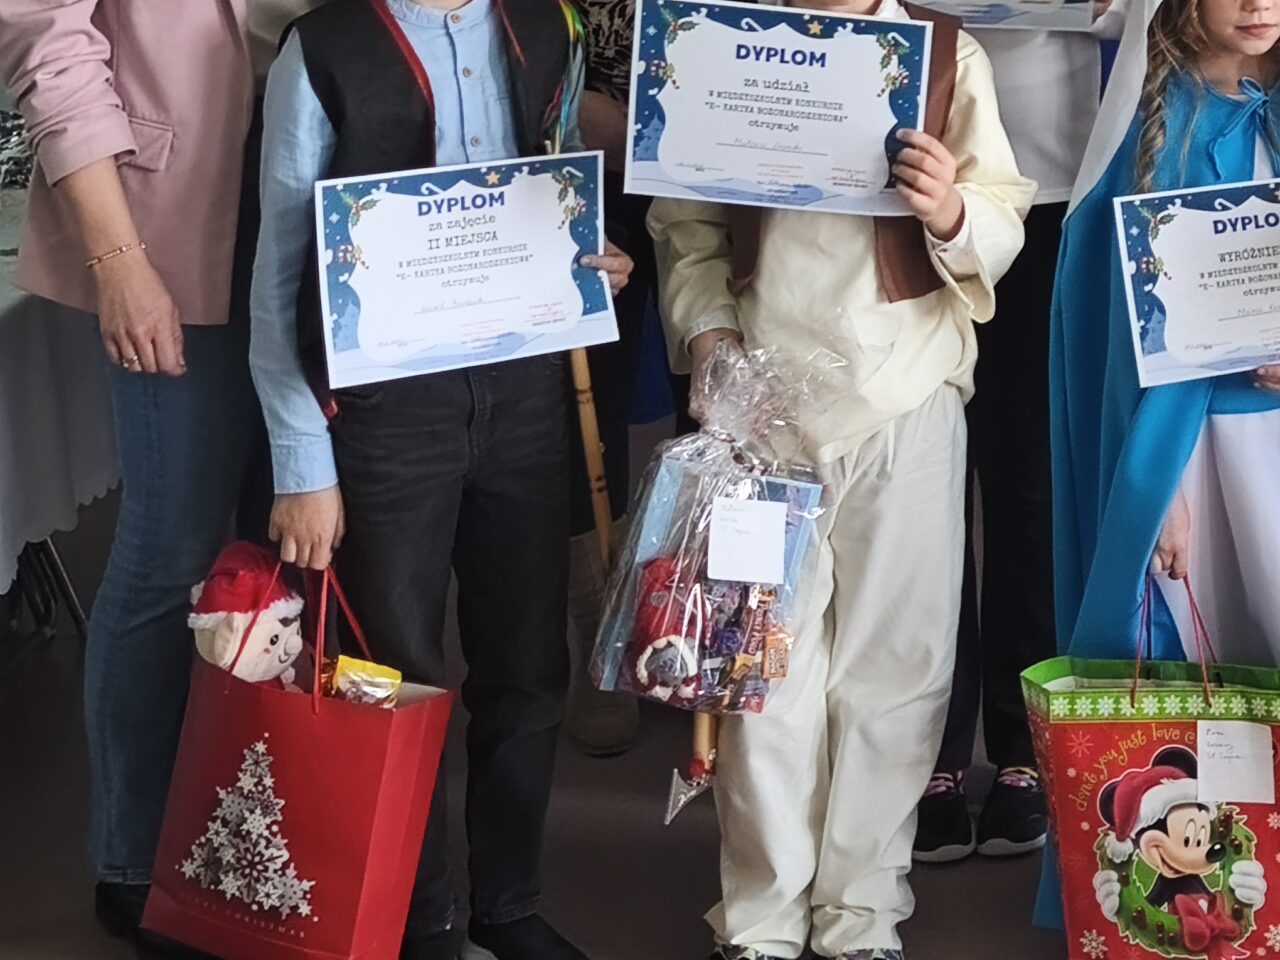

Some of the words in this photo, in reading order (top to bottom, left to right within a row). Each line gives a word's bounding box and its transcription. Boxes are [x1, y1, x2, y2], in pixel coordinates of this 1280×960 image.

[735, 43, 827, 68] DYPLOM
[744, 78, 759, 88] za
[763, 79, 810, 93] udział
[748, 119, 800, 132] otrzymuje
[417, 191, 505, 216] DYPLOM
[429, 222, 443, 231] za
[447, 214, 496, 230] zajęcie
[428, 238, 440, 250] II
[445, 230, 498, 247] MIEJSCA
[1216, 278, 1245, 289] KARTKA
[1094, 749, 1118, 781] you
[1115, 729, 1147, 766] just
[1151, 723, 1180, 740] love
